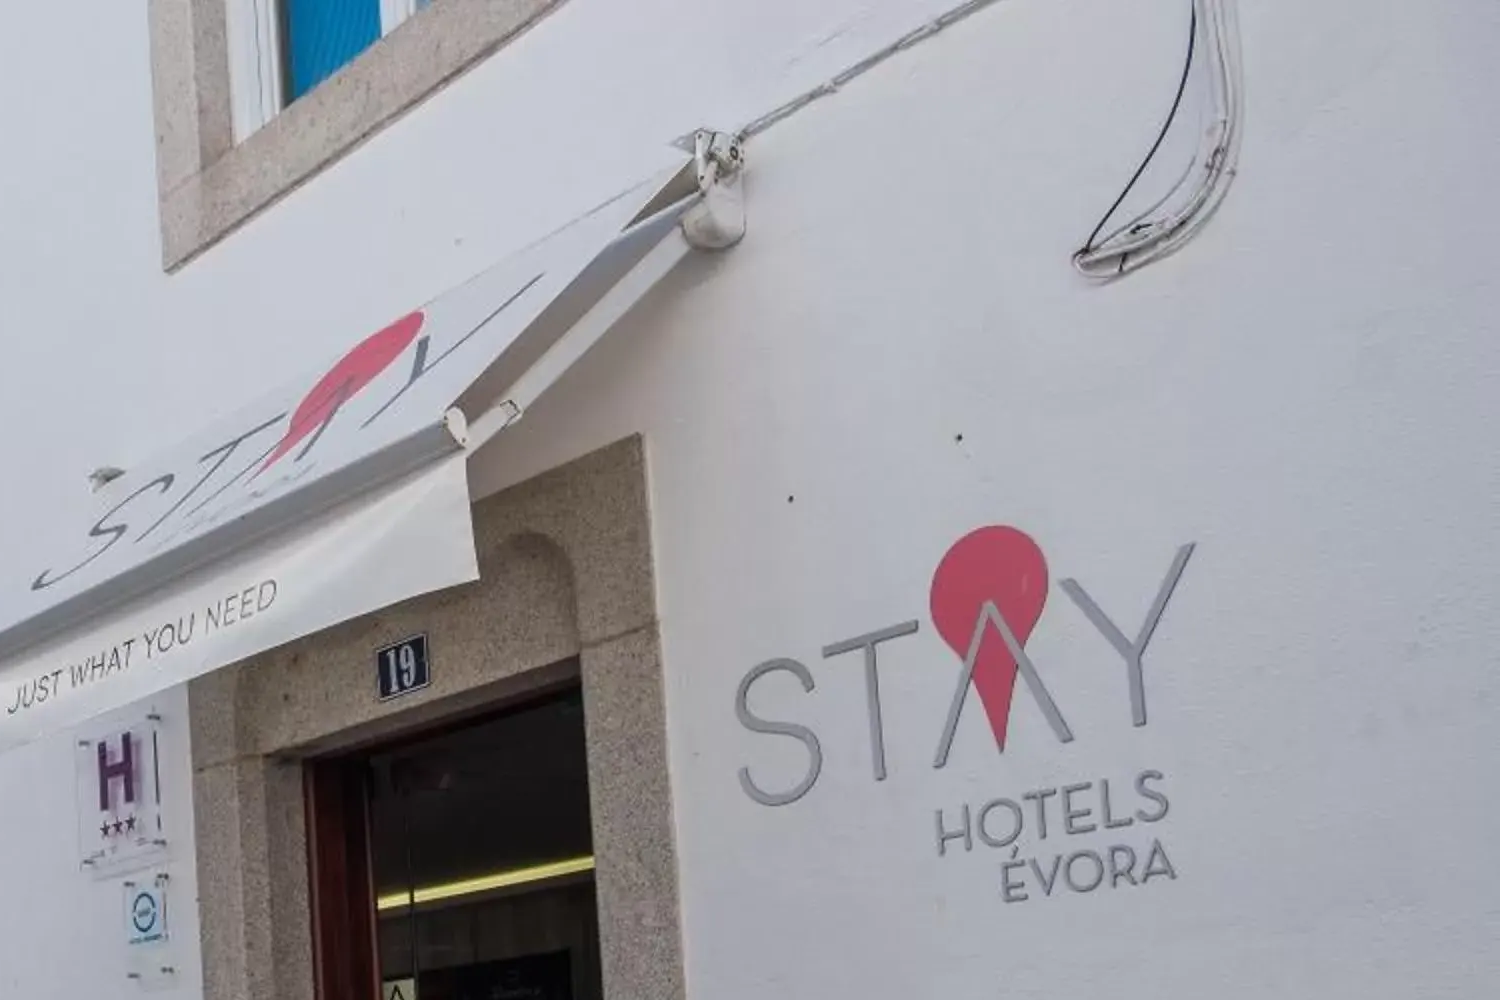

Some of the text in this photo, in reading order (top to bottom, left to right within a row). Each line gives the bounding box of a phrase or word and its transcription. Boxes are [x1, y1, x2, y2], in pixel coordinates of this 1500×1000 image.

[31, 272, 544, 591] STAY
[5, 578, 278, 715] JUST WHAT YOU NEED
[386, 643, 416, 693] 19
[735, 541, 1197, 806] STAY
[97, 731, 135, 811] H
[935, 769, 1171, 857] HOTELS
[1001, 838, 1177, 903] ÉVORA
